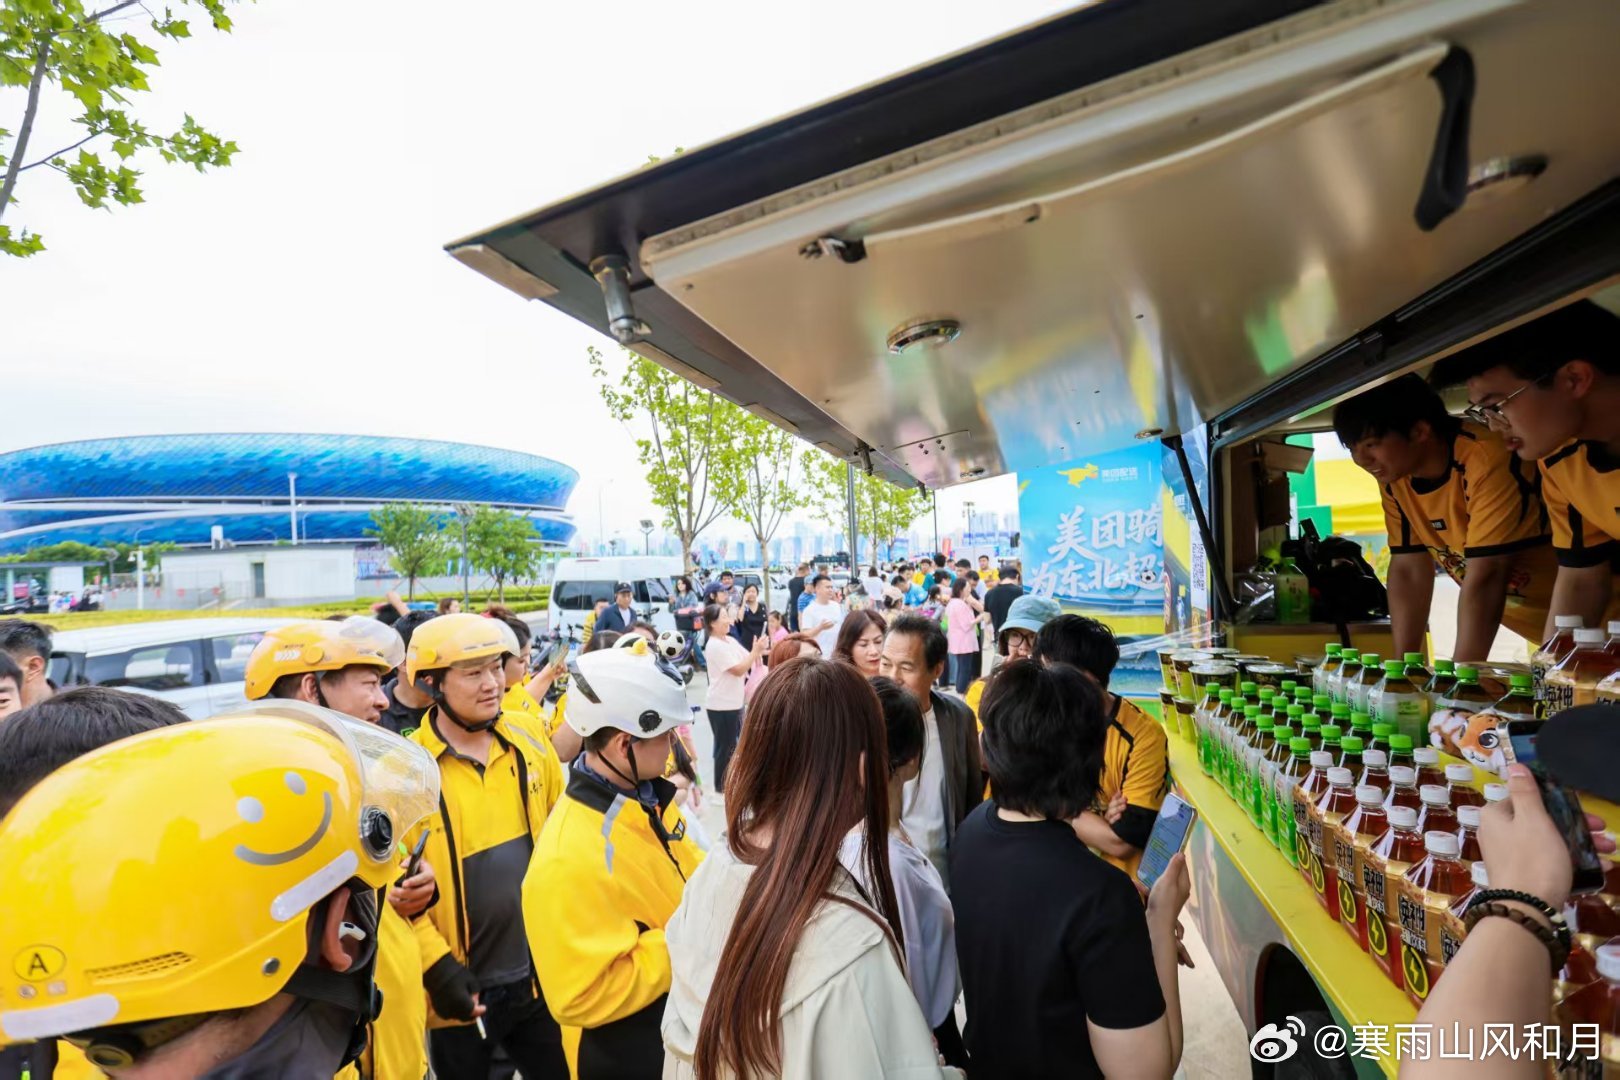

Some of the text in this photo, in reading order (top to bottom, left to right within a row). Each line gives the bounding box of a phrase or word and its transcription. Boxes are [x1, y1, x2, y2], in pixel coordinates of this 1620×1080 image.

[1047, 503, 1163, 563] 美团骑
[1029, 552, 1164, 599] 为东北超
[28, 952, 49, 976] A
